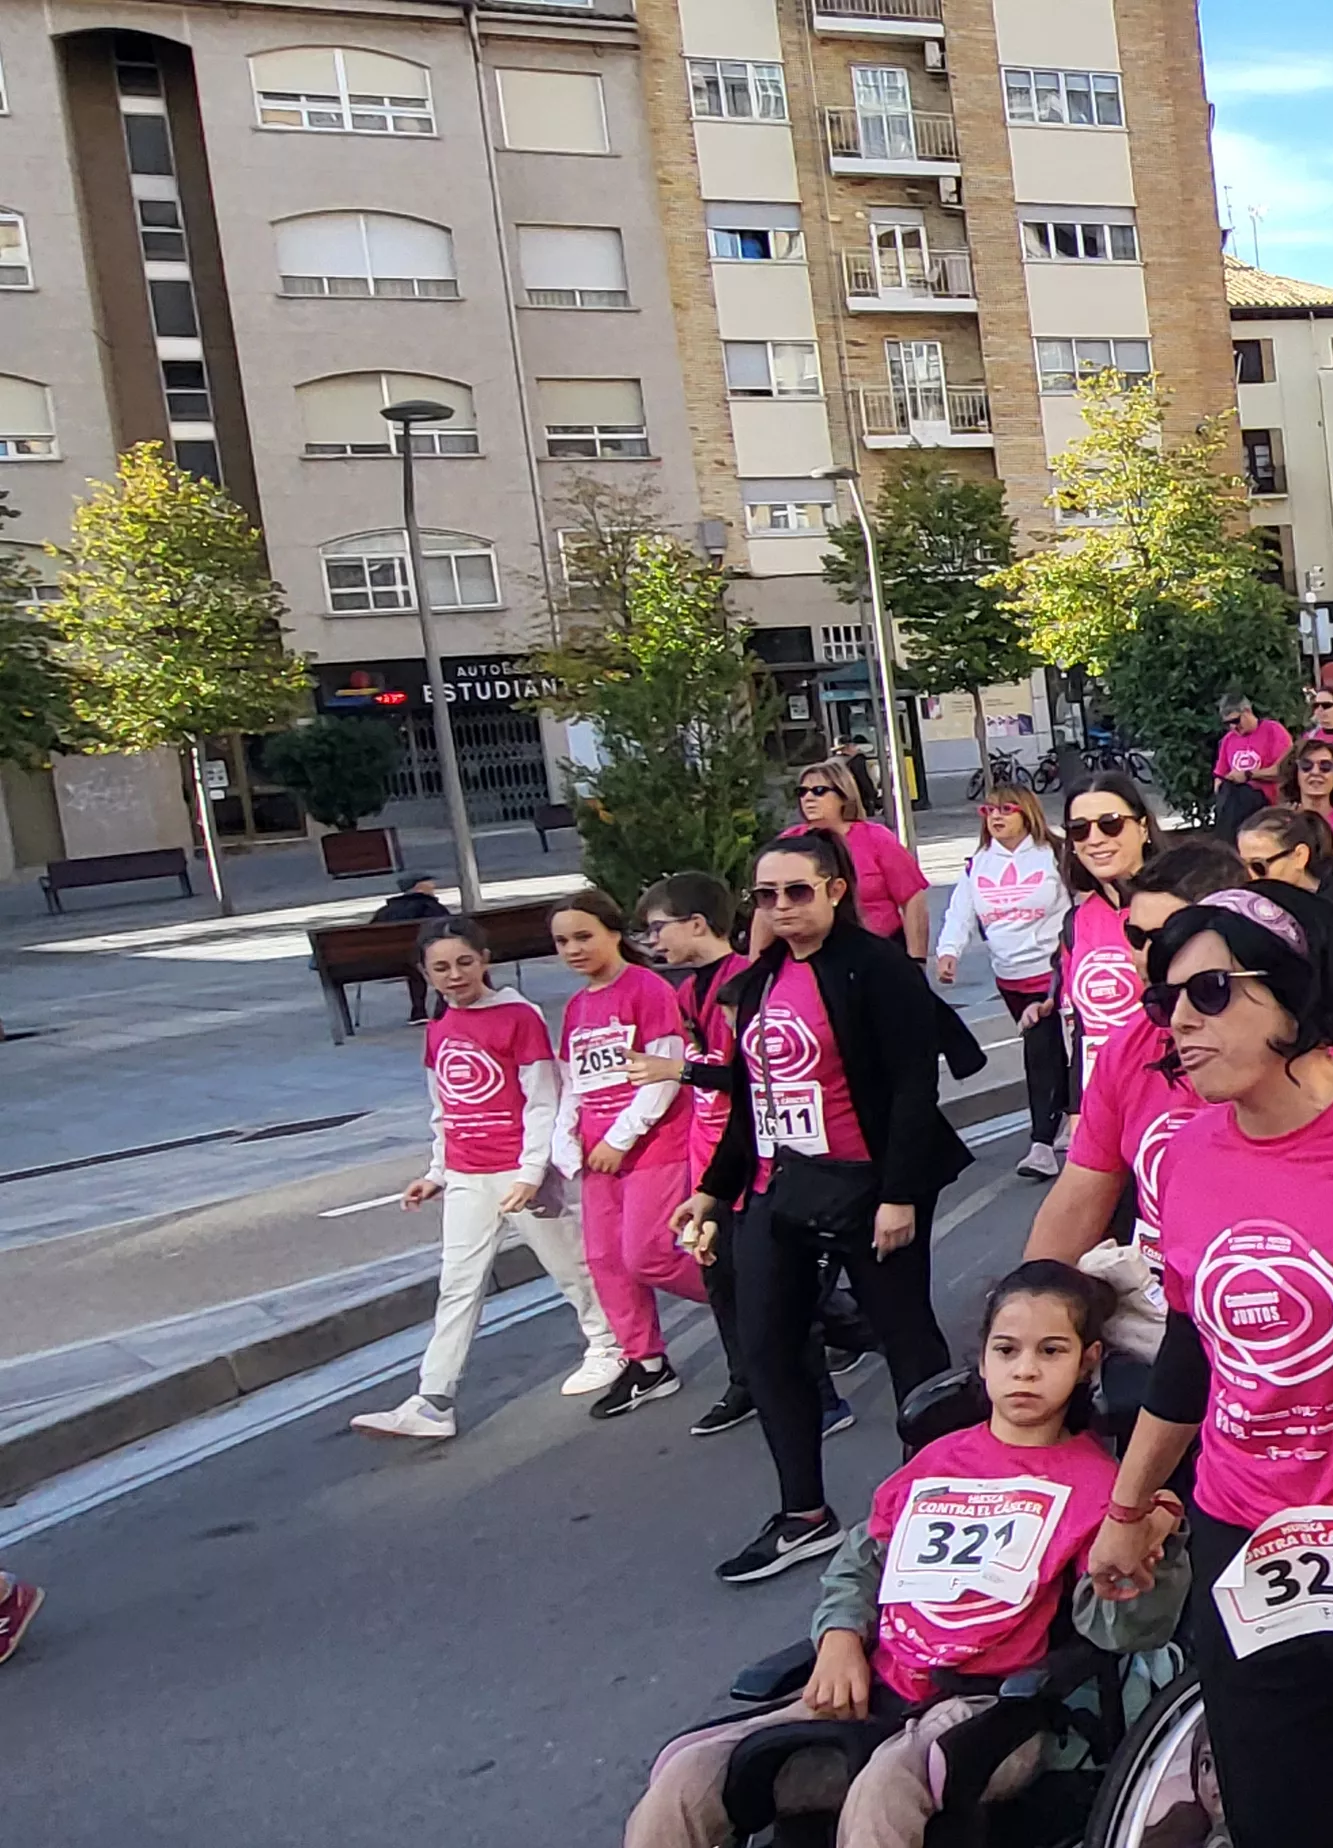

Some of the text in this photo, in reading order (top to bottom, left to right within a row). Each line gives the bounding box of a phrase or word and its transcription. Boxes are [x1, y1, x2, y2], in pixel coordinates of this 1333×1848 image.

[1233, 1306, 1280, 1326] JUNTOS
[918, 1501, 974, 1516] CONTRA
[977, 1504, 991, 1516] EL
[1246, 1536, 1300, 1562] ONTRA
[1300, 1533, 1315, 1545] EL
